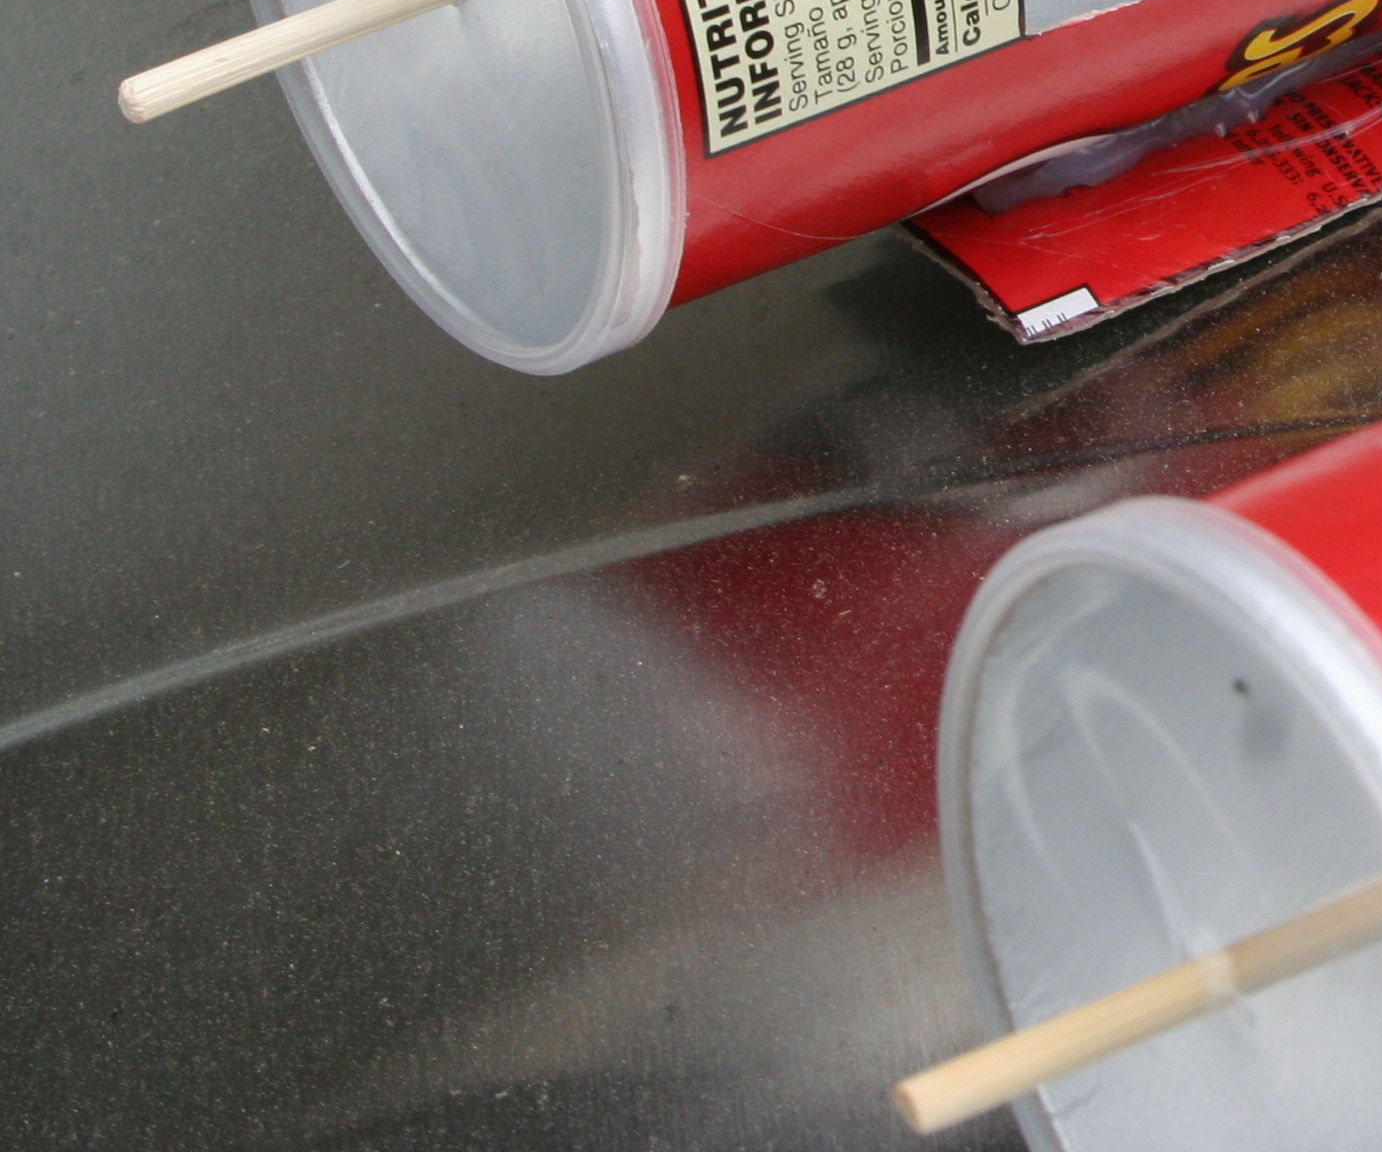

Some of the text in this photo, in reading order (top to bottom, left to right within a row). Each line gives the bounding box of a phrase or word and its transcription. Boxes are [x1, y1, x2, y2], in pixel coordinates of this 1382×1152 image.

[784, 22, 808, 111] Serving
[807, 6, 833, 104] Tamaño
[836, 56, 861, 94] (28
